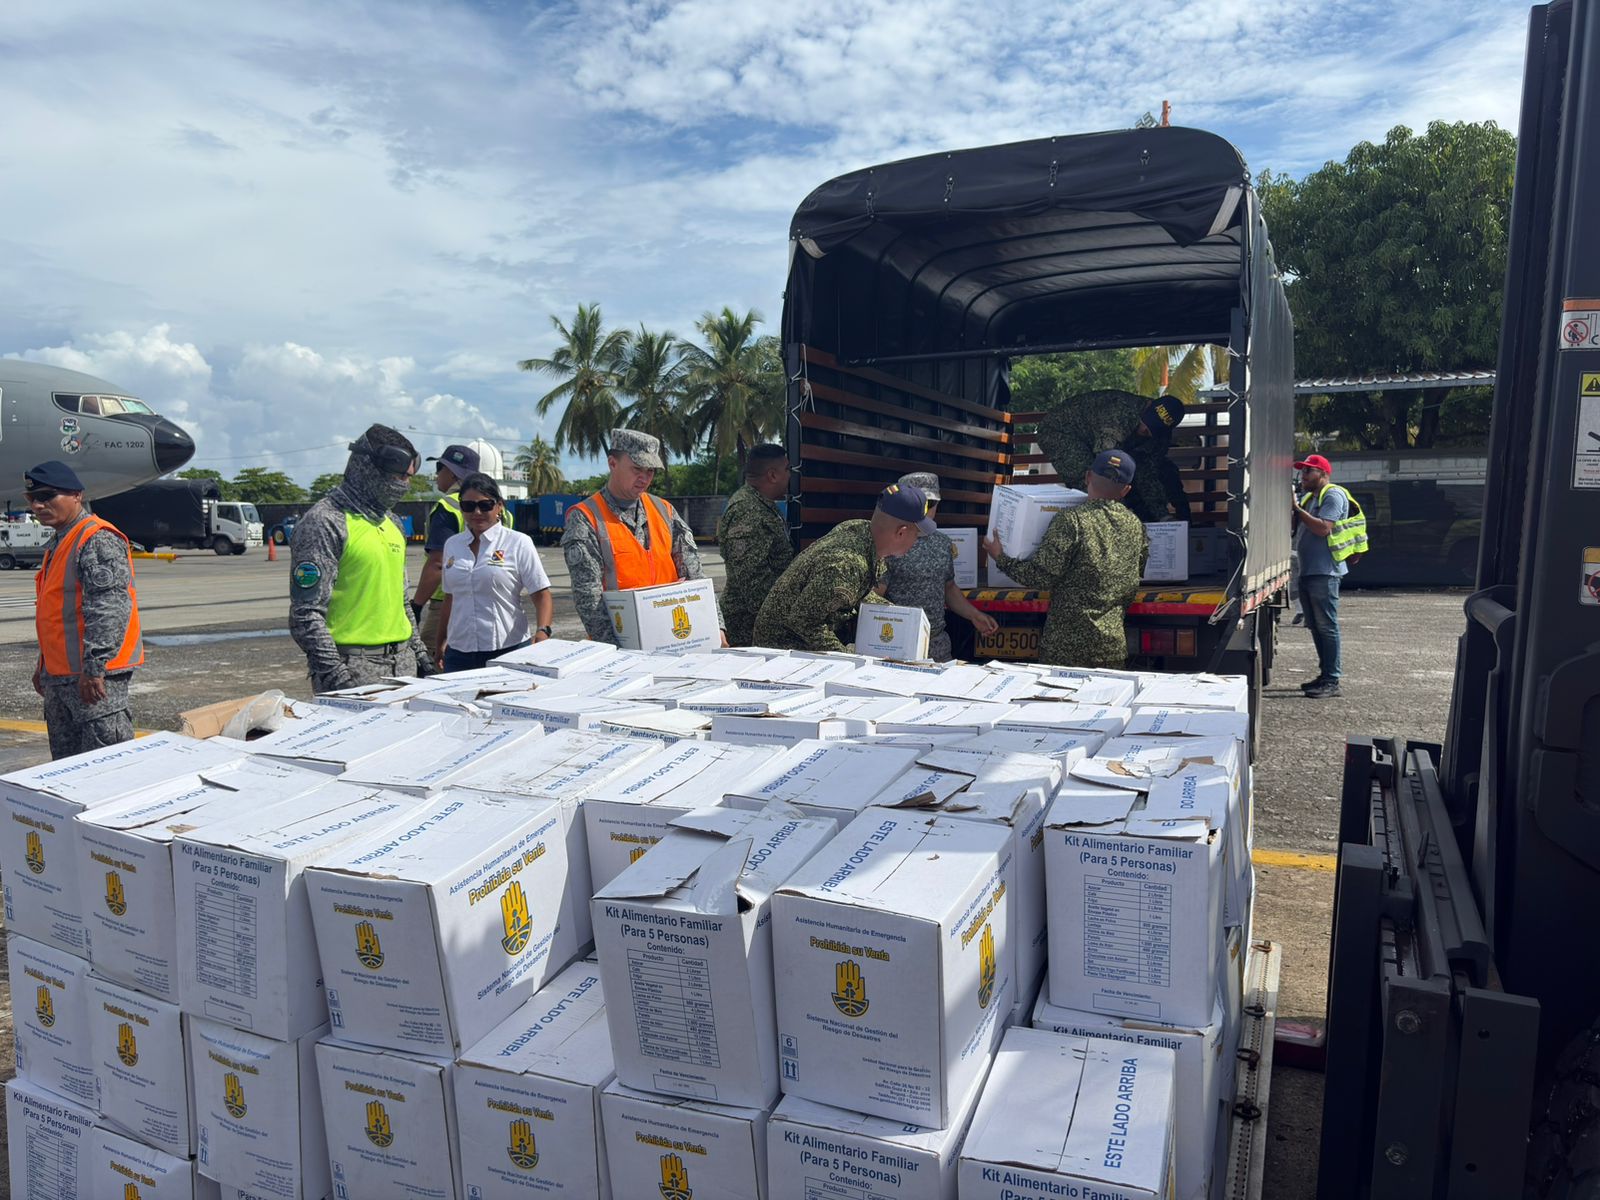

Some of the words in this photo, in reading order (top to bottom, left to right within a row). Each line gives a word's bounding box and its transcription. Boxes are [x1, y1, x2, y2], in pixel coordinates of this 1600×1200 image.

[104, 441, 123, 449] FAC
[126, 441, 145, 449] 1202
[1009, 631, 1039, 650] 500
[501, 708, 510, 716] Kit
[511, 708, 544, 720] Alimentario
[545, 713, 570, 724] Familiar
[678, 747, 700, 763] ESTE
[807, 748, 828, 764] ESTE
[653, 761, 680, 778] LADO
[786, 761, 811, 777] LADO
[620, 775, 655, 796] ARRIBA
[759, 772, 789, 794] ARRIBA
[427, 800, 464, 823] ESTE
[273, 832, 311, 850] ESTE
[313, 820, 352, 838] LADO
[350, 803, 400, 824] ARRIBA
[398, 817, 433, 842] LADO
[869, 820, 898, 842] ESTE
[351, 838, 400, 866] ARRIBA
[449, 868, 482, 896] Asistencia
[483, 845, 518, 872] Humanitaria
[518, 839, 526, 848] de
[526, 819, 557, 844] Emergencia
[748, 848, 772, 871] LADO
[766, 820, 802, 849] ARRIBA
[849, 840, 880, 864] LADO
[1065, 835, 1080, 847] Kit
[1082, 837, 1145, 854] Alimentario
[1148, 844, 1193, 859] Familiar
[182, 843, 192, 856] Kit
[194, 847, 238, 866] Alimentario
[240, 857, 272, 874] Familiar
[1079, 851, 1108, 866] (Para
[1111, 855, 1118, 866] 5
[1121, 857, 1176, 875] Personas)
[192, 860, 212, 874] (Para
[213, 865, 218, 876] 5
[220, 867, 260, 888] Personas)
[211, 878, 240, 892] Contenido:
[468, 867, 512, 906] Prohibida
[512, 858, 524, 876] su
[522, 841, 546, 866] Venta
[816, 862, 857, 893] ARRIBA
[1107, 868, 1149, 880] Contenido:
[333, 902, 364, 917] Prohibida
[364, 908, 374, 918] su
[374, 907, 394, 920] Venta
[605, 905, 620, 919] Kit
[622, 909, 678, 927] Alimentario
[680, 916, 723, 932] Familiar
[620, 924, 647, 938] (Para
[649, 930, 656, 940] 5
[658, 931, 710, 949] Personas)
[795, 916, 824, 928] Asistencia
[826, 922, 860, 934] Humanitaria
[862, 928, 870, 936] de
[871, 930, 907, 942] Emergencia
[647, 942, 686, 956] Contenido:
[810, 936, 852, 954] Prohibida
[851, 945, 864, 956] su
[863, 946, 890, 962] Venta
[477, 976, 502, 1000] Sistema
[501, 956, 526, 980] Nacional
[532, 931, 553, 954] Gestión
[495, 974, 516, 997] Riesgo
[523, 947, 549, 974] Desastres
[568, 976, 598, 999] ESTE
[540, 998, 573, 1023] LADO
[806, 1013, 828, 1024] Sistema
[829, 1019, 855, 1030] Nacional
[864, 1026, 888, 1037] Gestión
[888, 1032, 898, 1040] del
[822, 1025, 843, 1036] Riesgo
[852, 1030, 881, 1042] Desastres
[497, 1023, 544, 1057] ARRIBA
[786, 1037, 792, 1048] 6
[1137, 1034, 1183, 1050] Familiar
[1122, 1057, 1138, 1102] ARRIBA
[13, 1091, 22, 1102] Kit
[24, 1094, 62, 1118] Alimentario
[64, 1110, 92, 1128] Familiar
[487, 1097, 522, 1114] Prohibida
[522, 1106, 532, 1116] su
[532, 1106, 554, 1121] Venta
[1112, 1103, 1131, 1136] LADO
[23, 1106, 40, 1122] (Para
[41, 1113, 46, 1123] 5
[47, 1116, 82, 1138] Personas)
[621, 1113, 648, 1124] Asistencia
[649, 1119, 680, 1130] Humanitaria
[688, 1127, 720, 1139] Emergencia
[635, 1130, 672, 1148] Prohibida
[672, 1140, 684, 1150] su
[683, 1140, 708, 1155] Venta
[784, 1130, 800, 1144] Kit
[802, 1135, 868, 1160] Alimentario
[871, 1150, 920, 1172] Familiar
[1104, 1138, 1126, 1169] ESTE
[800, 1151, 830, 1168] (Para
[832, 1158, 840, 1170] 5
[843, 1160, 902, 1188] Personas)
[829, 1172, 873, 1190] Contenido:
[823, 1182, 848, 1194] Producto
[982, 1167, 1000, 1183] Kit
[1003, 1172, 1078, 1198] Alimentario
